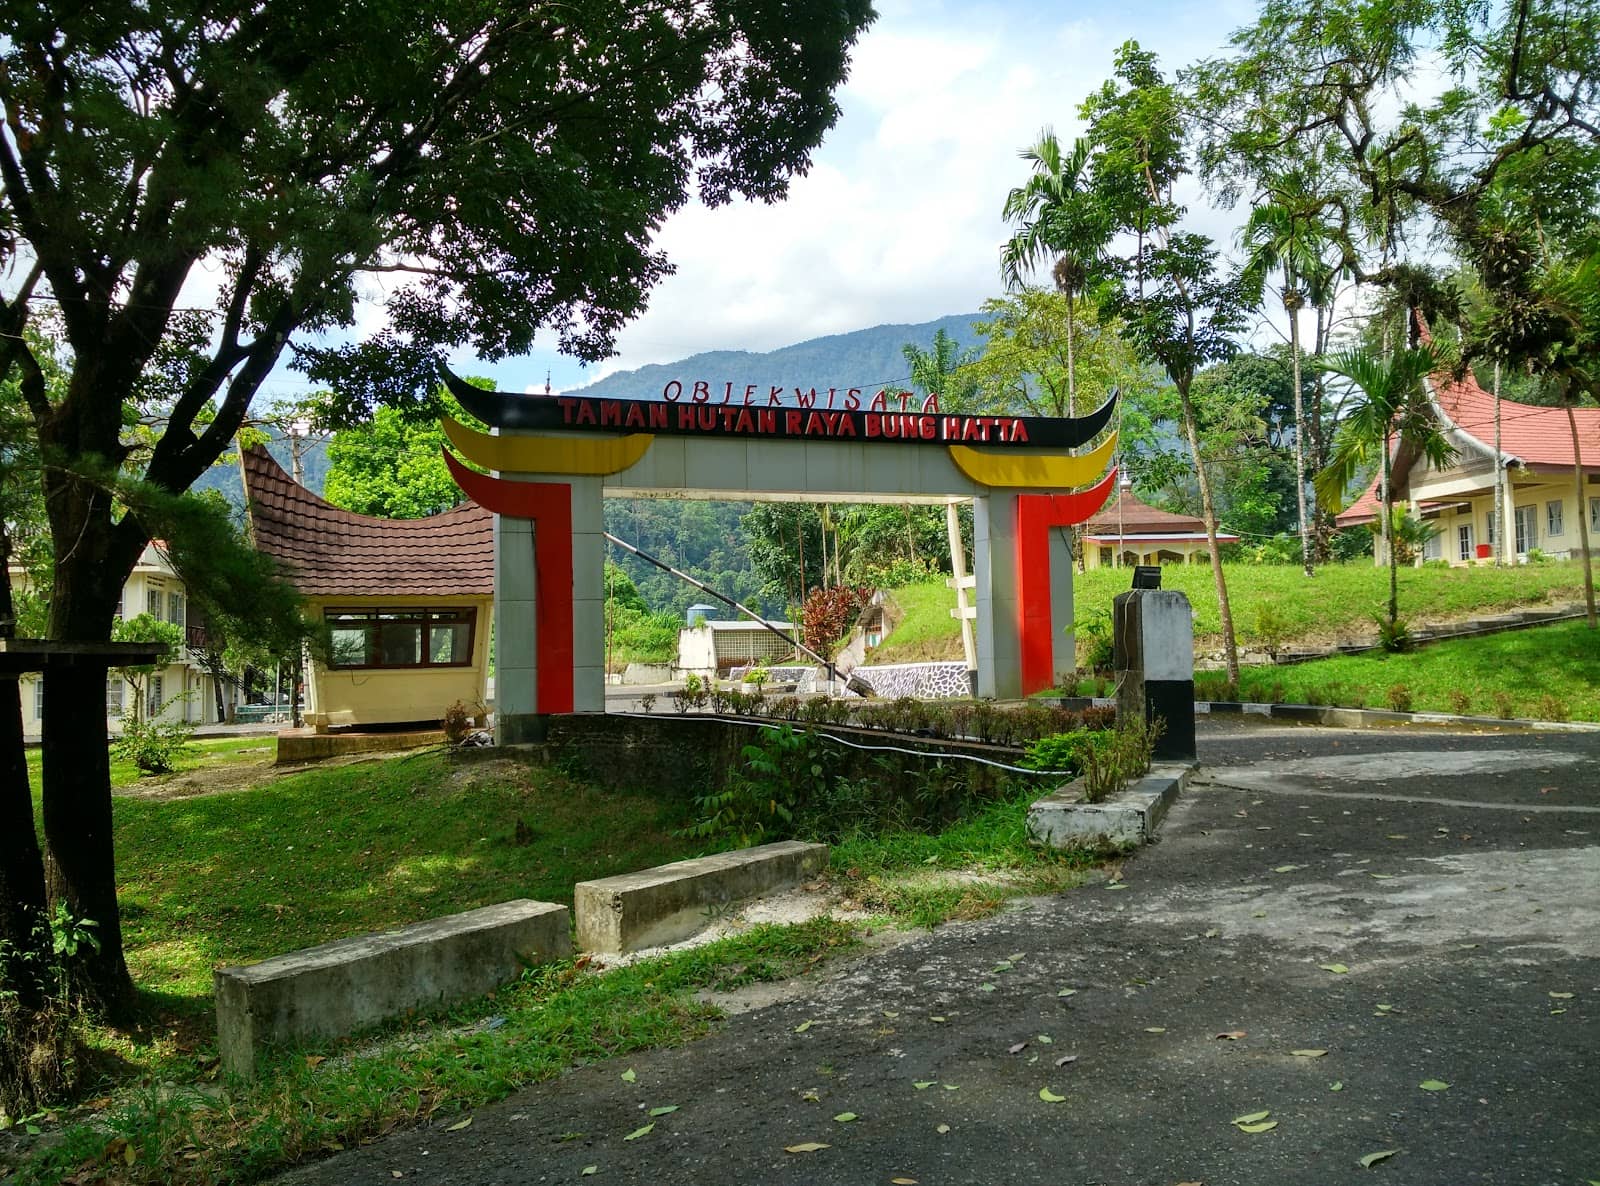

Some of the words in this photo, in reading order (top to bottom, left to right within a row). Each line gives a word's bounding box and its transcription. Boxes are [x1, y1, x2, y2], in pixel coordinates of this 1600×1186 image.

[558, 399, 669, 428] TAMAN
[677, 407, 776, 434] HUTAN
[785, 410, 857, 436] RAYA
[865, 413, 937, 439] BUNG
[943, 417, 1030, 442] HATTA
